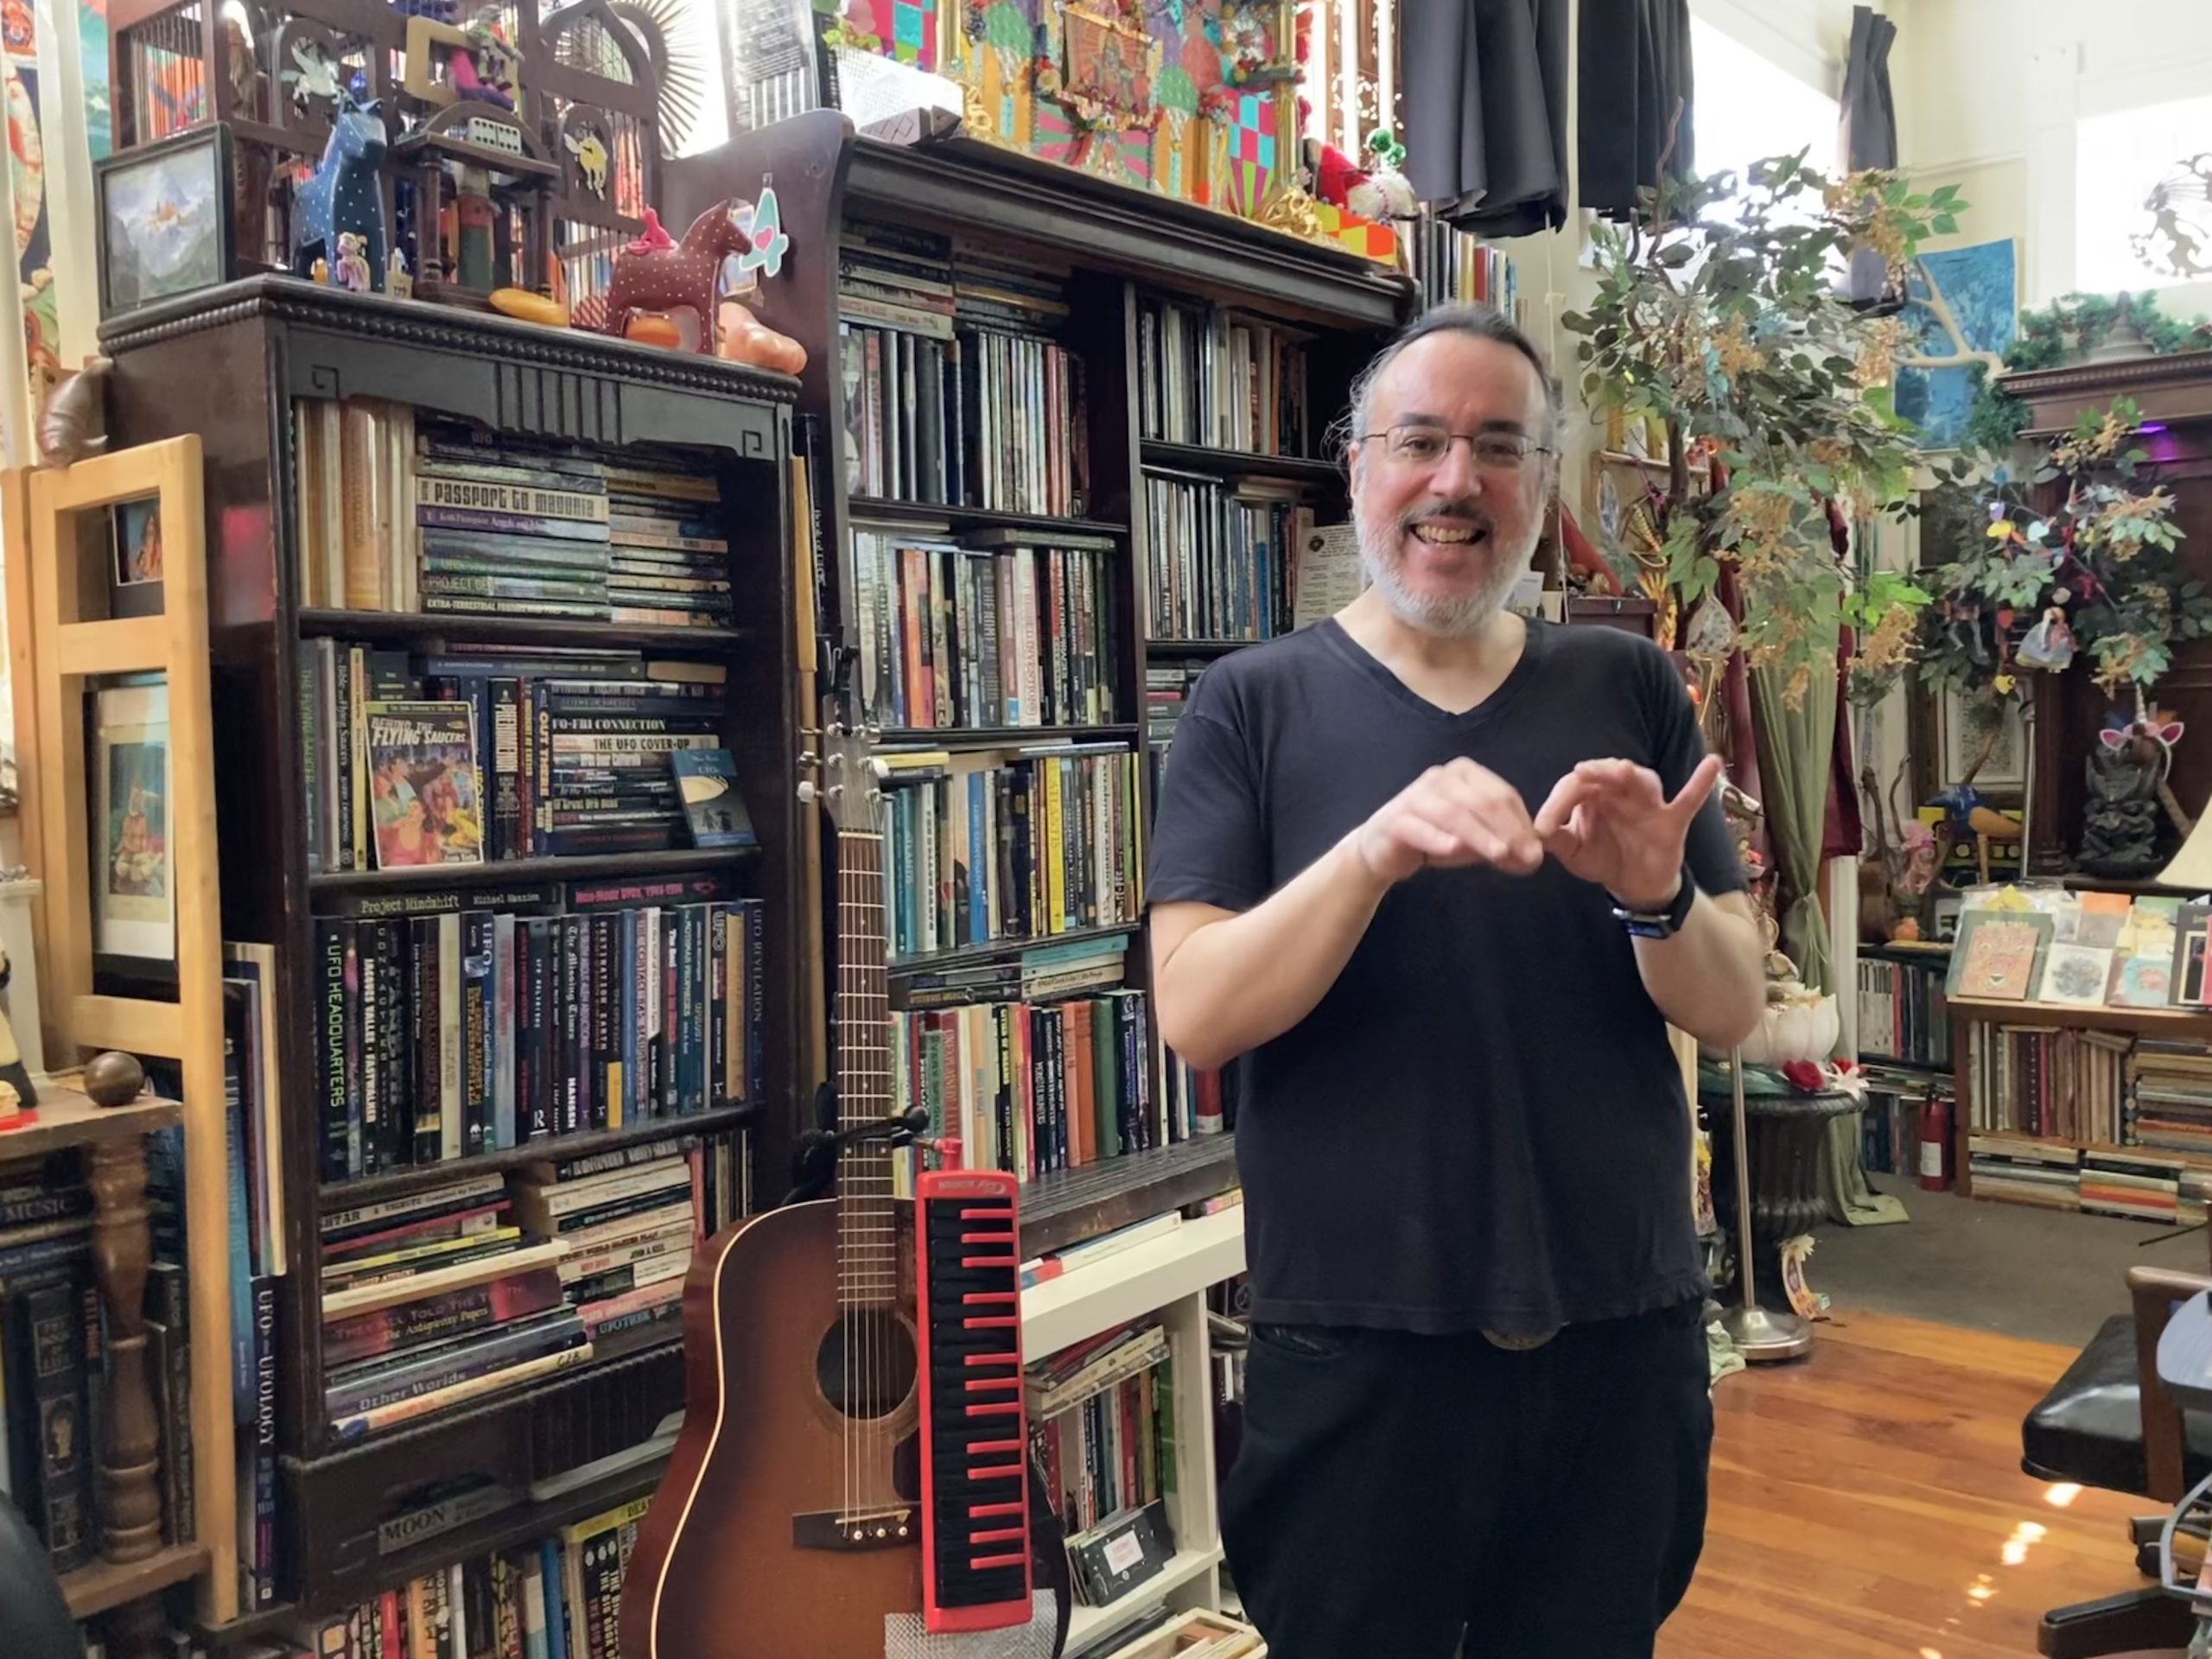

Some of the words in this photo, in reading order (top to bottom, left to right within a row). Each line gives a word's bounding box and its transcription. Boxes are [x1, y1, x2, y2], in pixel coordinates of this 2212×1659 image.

[337, 664, 350, 689] Bible
[372, 726, 422, 747] FLYING
[423, 729, 467, 745] SAUCERS
[416, 721, 435, 734] THE
[495, 704, 518, 772] PHENOMENON
[539, 711, 550, 745] OUT
[594, 719, 666, 731] CONNECTION
[339, 730, 350, 766] Saucers
[593, 738, 613, 751] THE
[616, 738, 637, 751] UFO
[640, 739, 690, 751] COVER-UP
[539, 748, 550, 797] THERE
[905, 830, 913, 885] ATLANTIS
[361, 895, 403, 915] Project
[406, 893, 461, 912] Mindshift
[567, 925, 580, 947] The
[668, 928, 678, 947] The
[711, 910, 727, 952] UFO
[753, 907, 764, 938] UFO
[327, 945, 343, 978] UFO
[567, 952, 580, 1002] Missing
[365, 958, 377, 1003] JACQUES
[753, 940, 764, 1023] REVELATION
[365, 1006, 377, 1044] VALLEE
[567, 1003, 580, 1040] Times
[327, 982, 343, 1108] HEADQUARTERS
[365, 1053, 377, 1124] FASTWALKER
[568, 1077, 577, 1129] HANSEN
[410, 1300, 448, 1319] TOLD
[450, 1296, 480, 1313] THE
[461, 1307, 489, 1325] Papers
[255, 1354, 275, 1445] UFOLOGY
[359, 1382, 410, 1411] Other
[412, 1370, 467, 1395] Worlds
[384, 1508, 447, 1539] MOON
[600, 1570, 610, 1592] THE
[601, 1594, 612, 1615] BIG
[604, 1616, 614, 1649] BOOK
